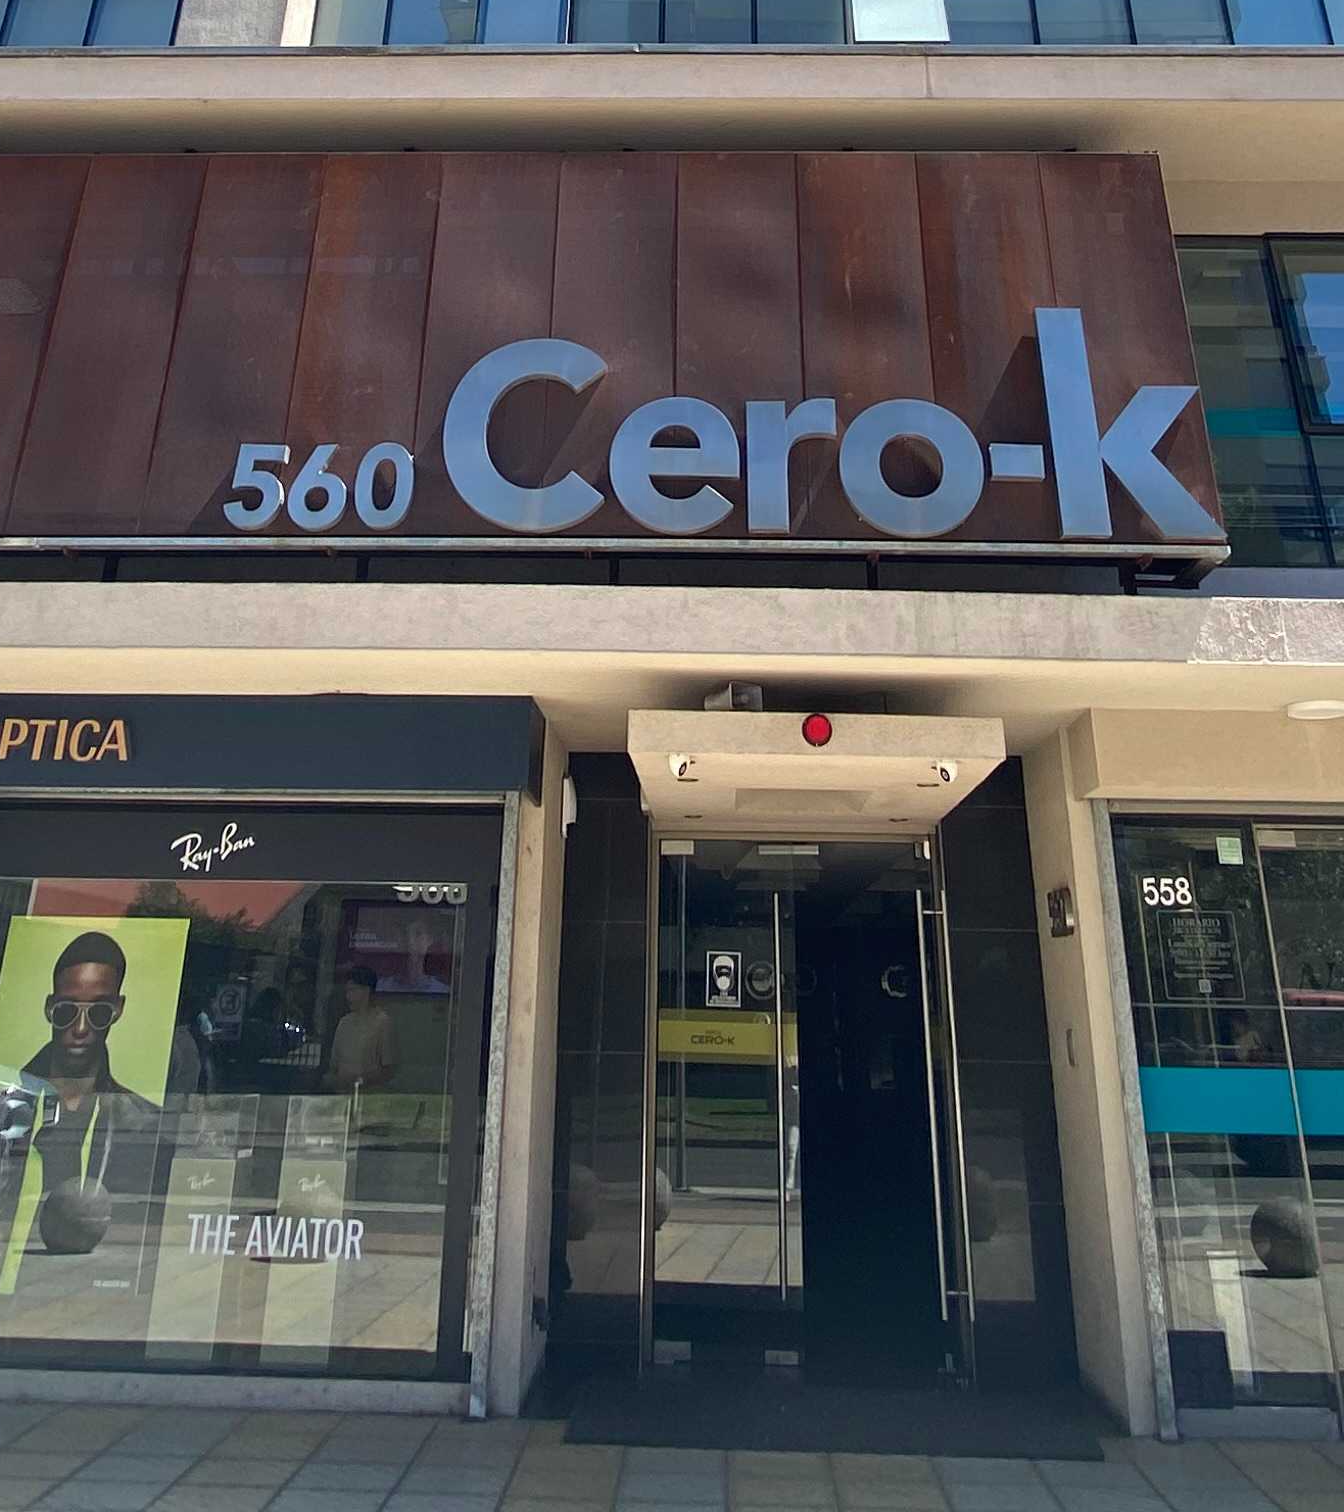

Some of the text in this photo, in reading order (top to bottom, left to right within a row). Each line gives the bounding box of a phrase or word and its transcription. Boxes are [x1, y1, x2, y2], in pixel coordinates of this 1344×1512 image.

[223, 442, 416, 532] 560
[169, 821, 256, 873] Ray-Ban
[1142, 877, 1193, 906] 558
[188, 1213, 364, 1260] THE AVIATOR
